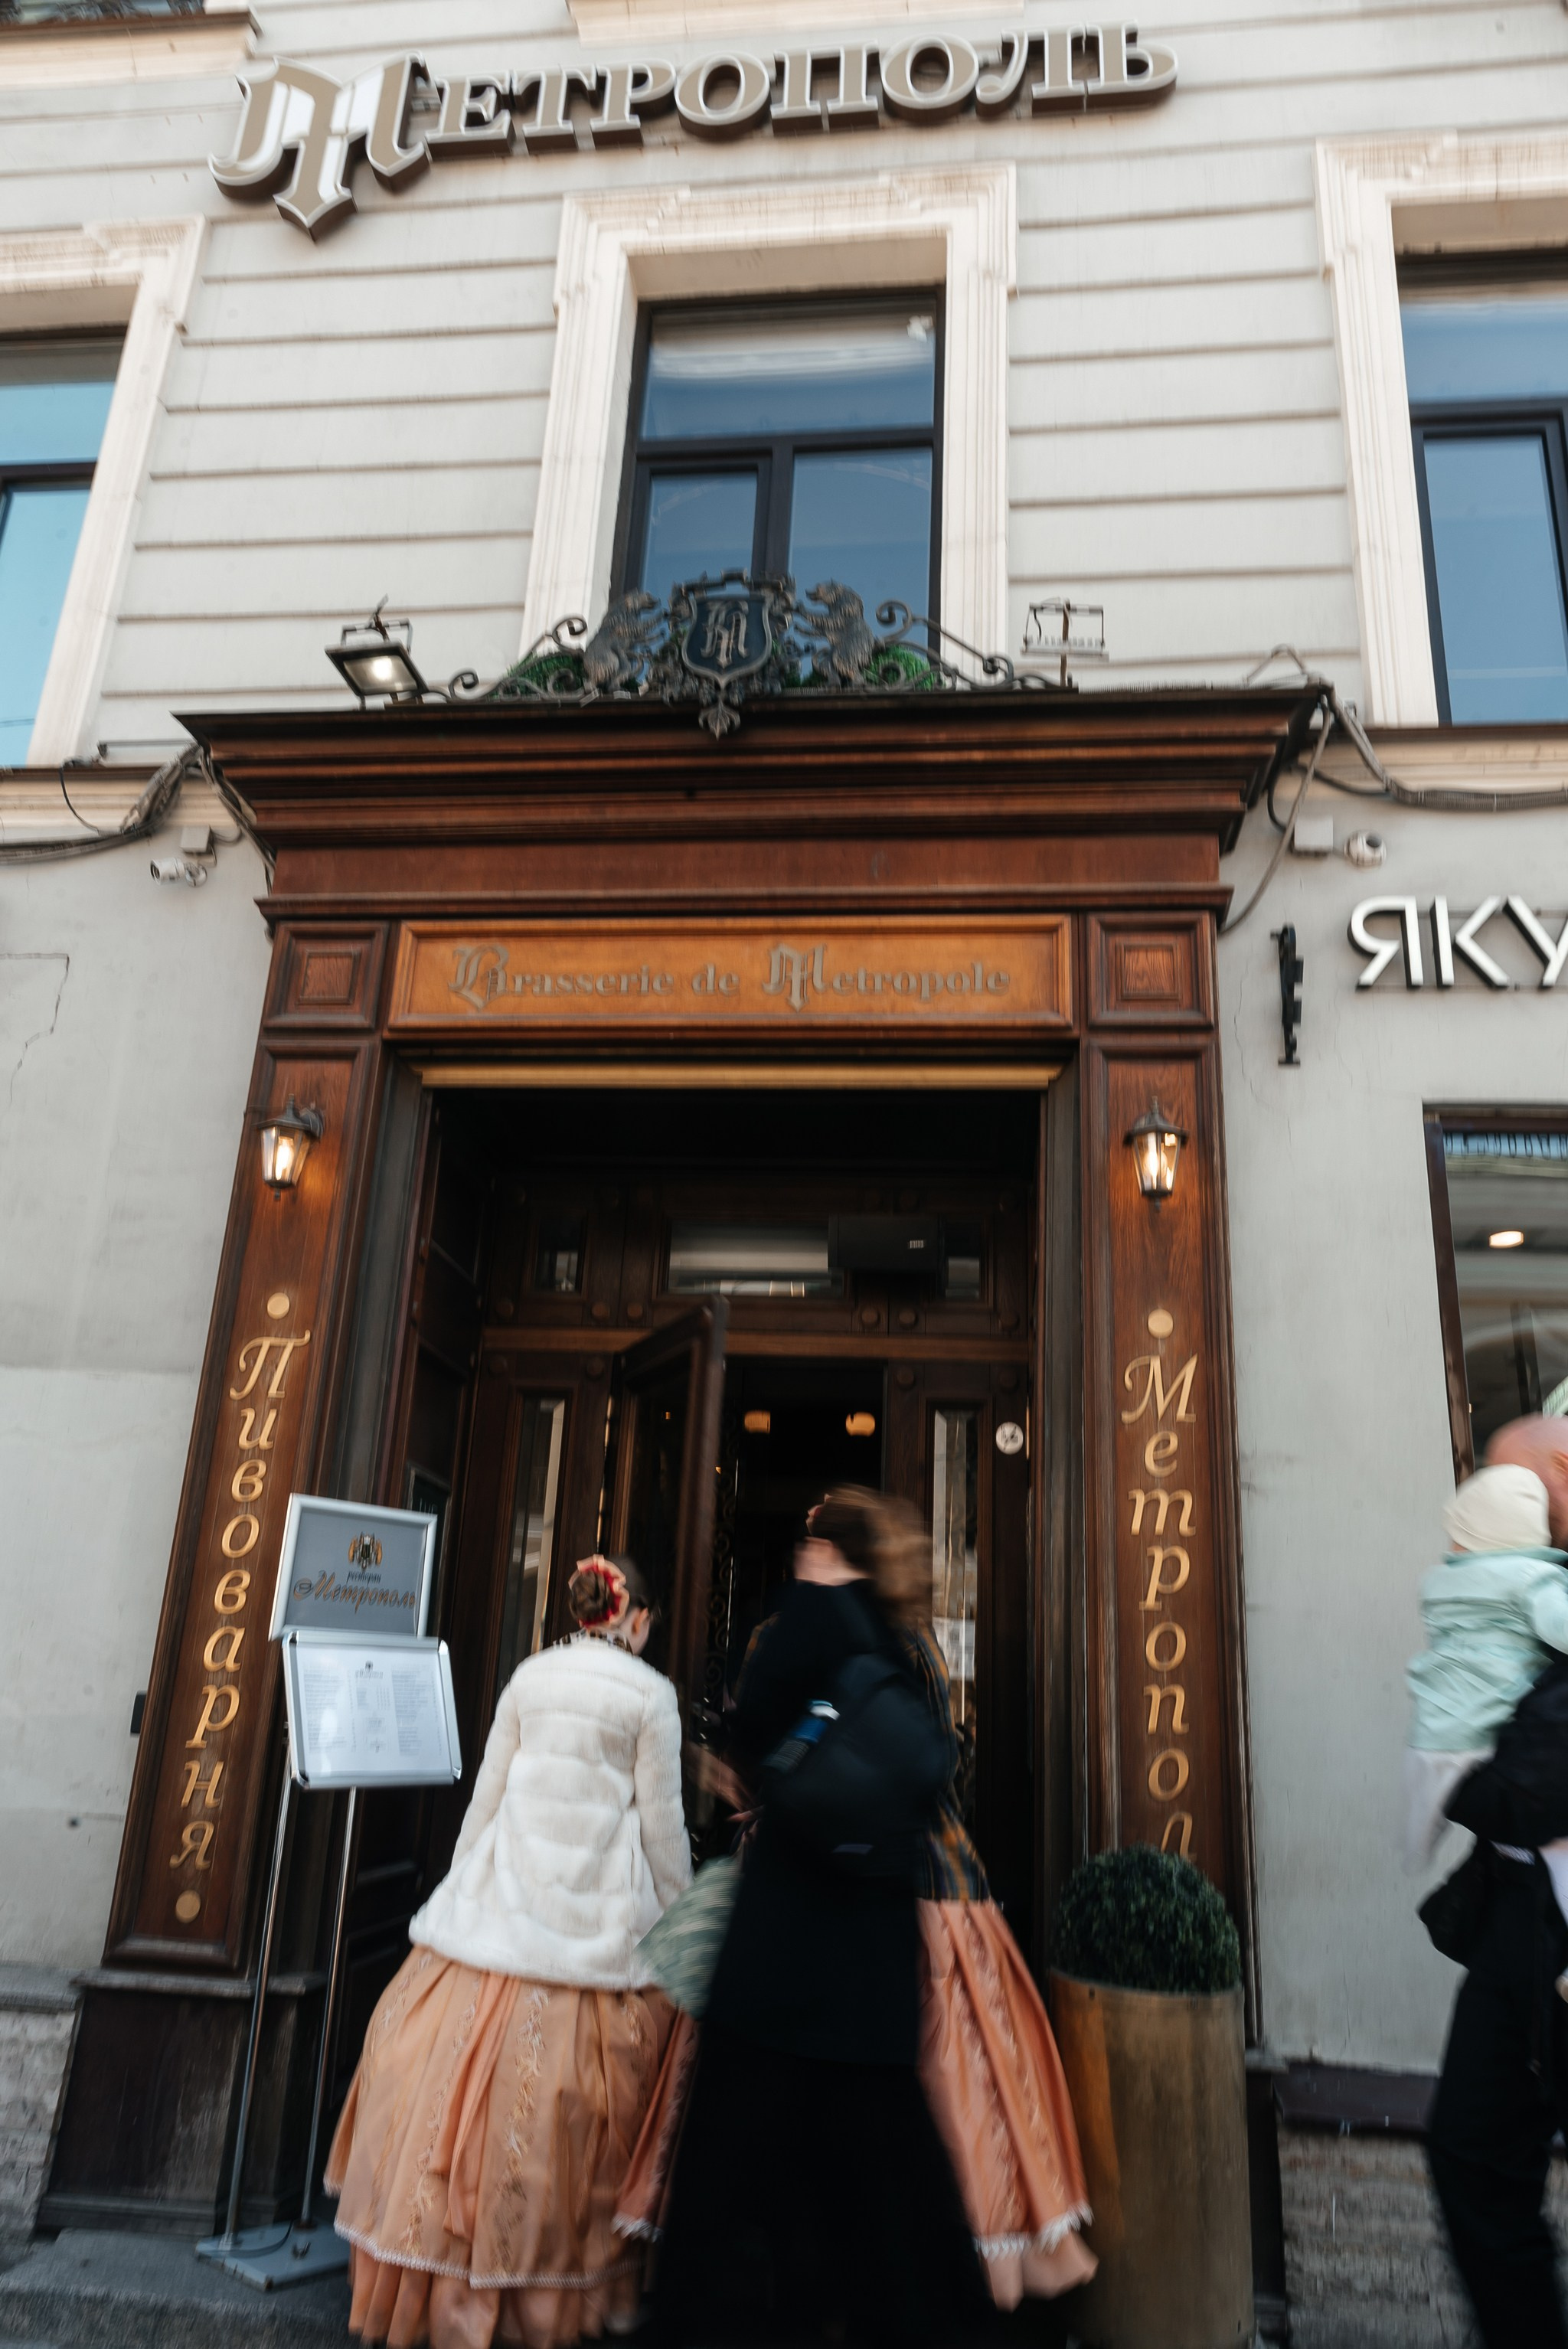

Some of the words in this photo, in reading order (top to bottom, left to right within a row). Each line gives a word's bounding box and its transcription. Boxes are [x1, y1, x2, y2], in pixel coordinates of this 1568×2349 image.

[447, 943, 674, 1011] Brasserie
[692, 962, 740, 996] de
[761, 943, 1011, 1011] Metropole
[170, 1331, 310, 1871] Пивоварня
[1121, 1353, 1198, 1861] Метропол
